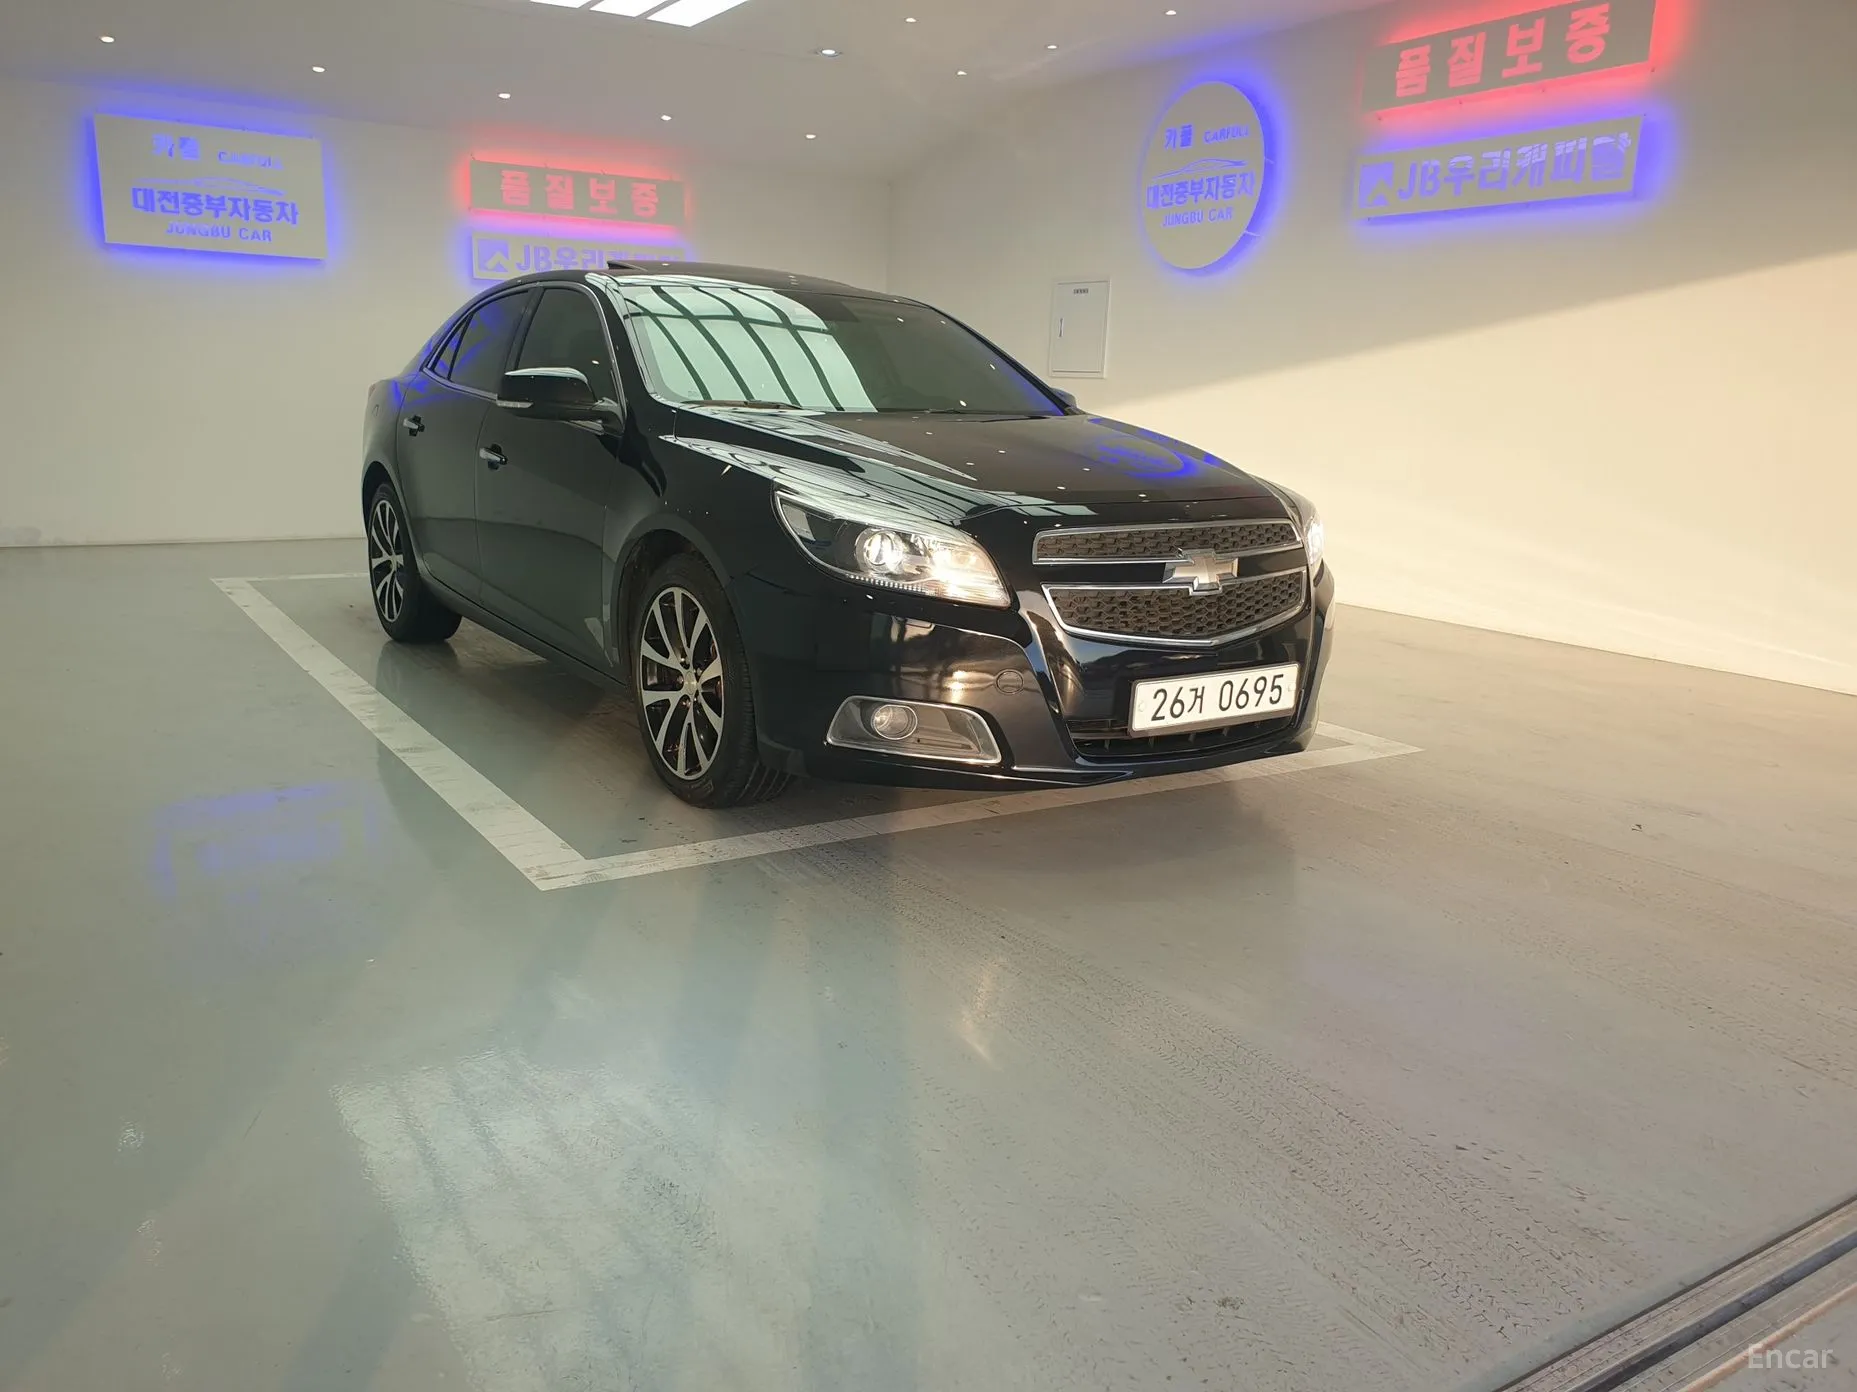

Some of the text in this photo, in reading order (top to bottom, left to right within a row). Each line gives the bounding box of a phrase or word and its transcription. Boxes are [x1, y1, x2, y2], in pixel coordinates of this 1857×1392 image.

[1395, 2, 1611, 98] 품질보증
[500, 169, 659, 218] 품질보증
[1208, 207, 1234, 222] CAR
[238, 227, 273, 242] CAR
[1151, 673, 1285, 722] 26거 0695
